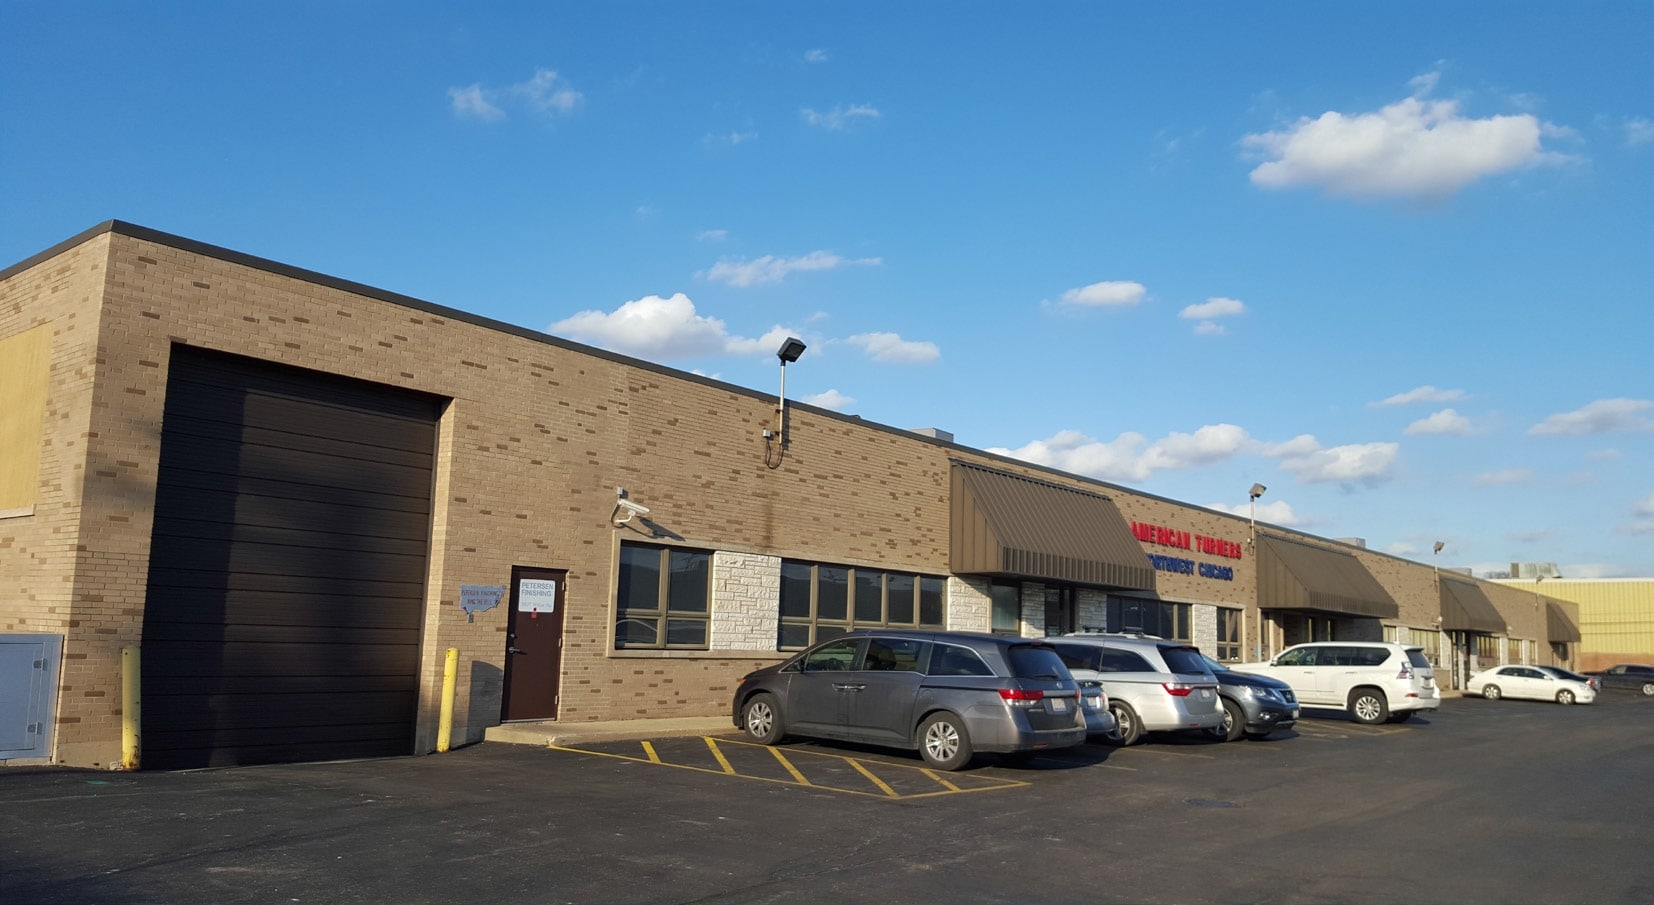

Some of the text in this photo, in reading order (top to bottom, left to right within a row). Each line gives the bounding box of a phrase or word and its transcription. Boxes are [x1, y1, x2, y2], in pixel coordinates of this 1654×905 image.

[1130, 520, 1242, 560] AMERICAN TURNERS
[1198, 562, 1233, 581] CHICAGO
[521, 582, 554, 590] PETERSEN
[521, 589, 552, 597] FINISHING
